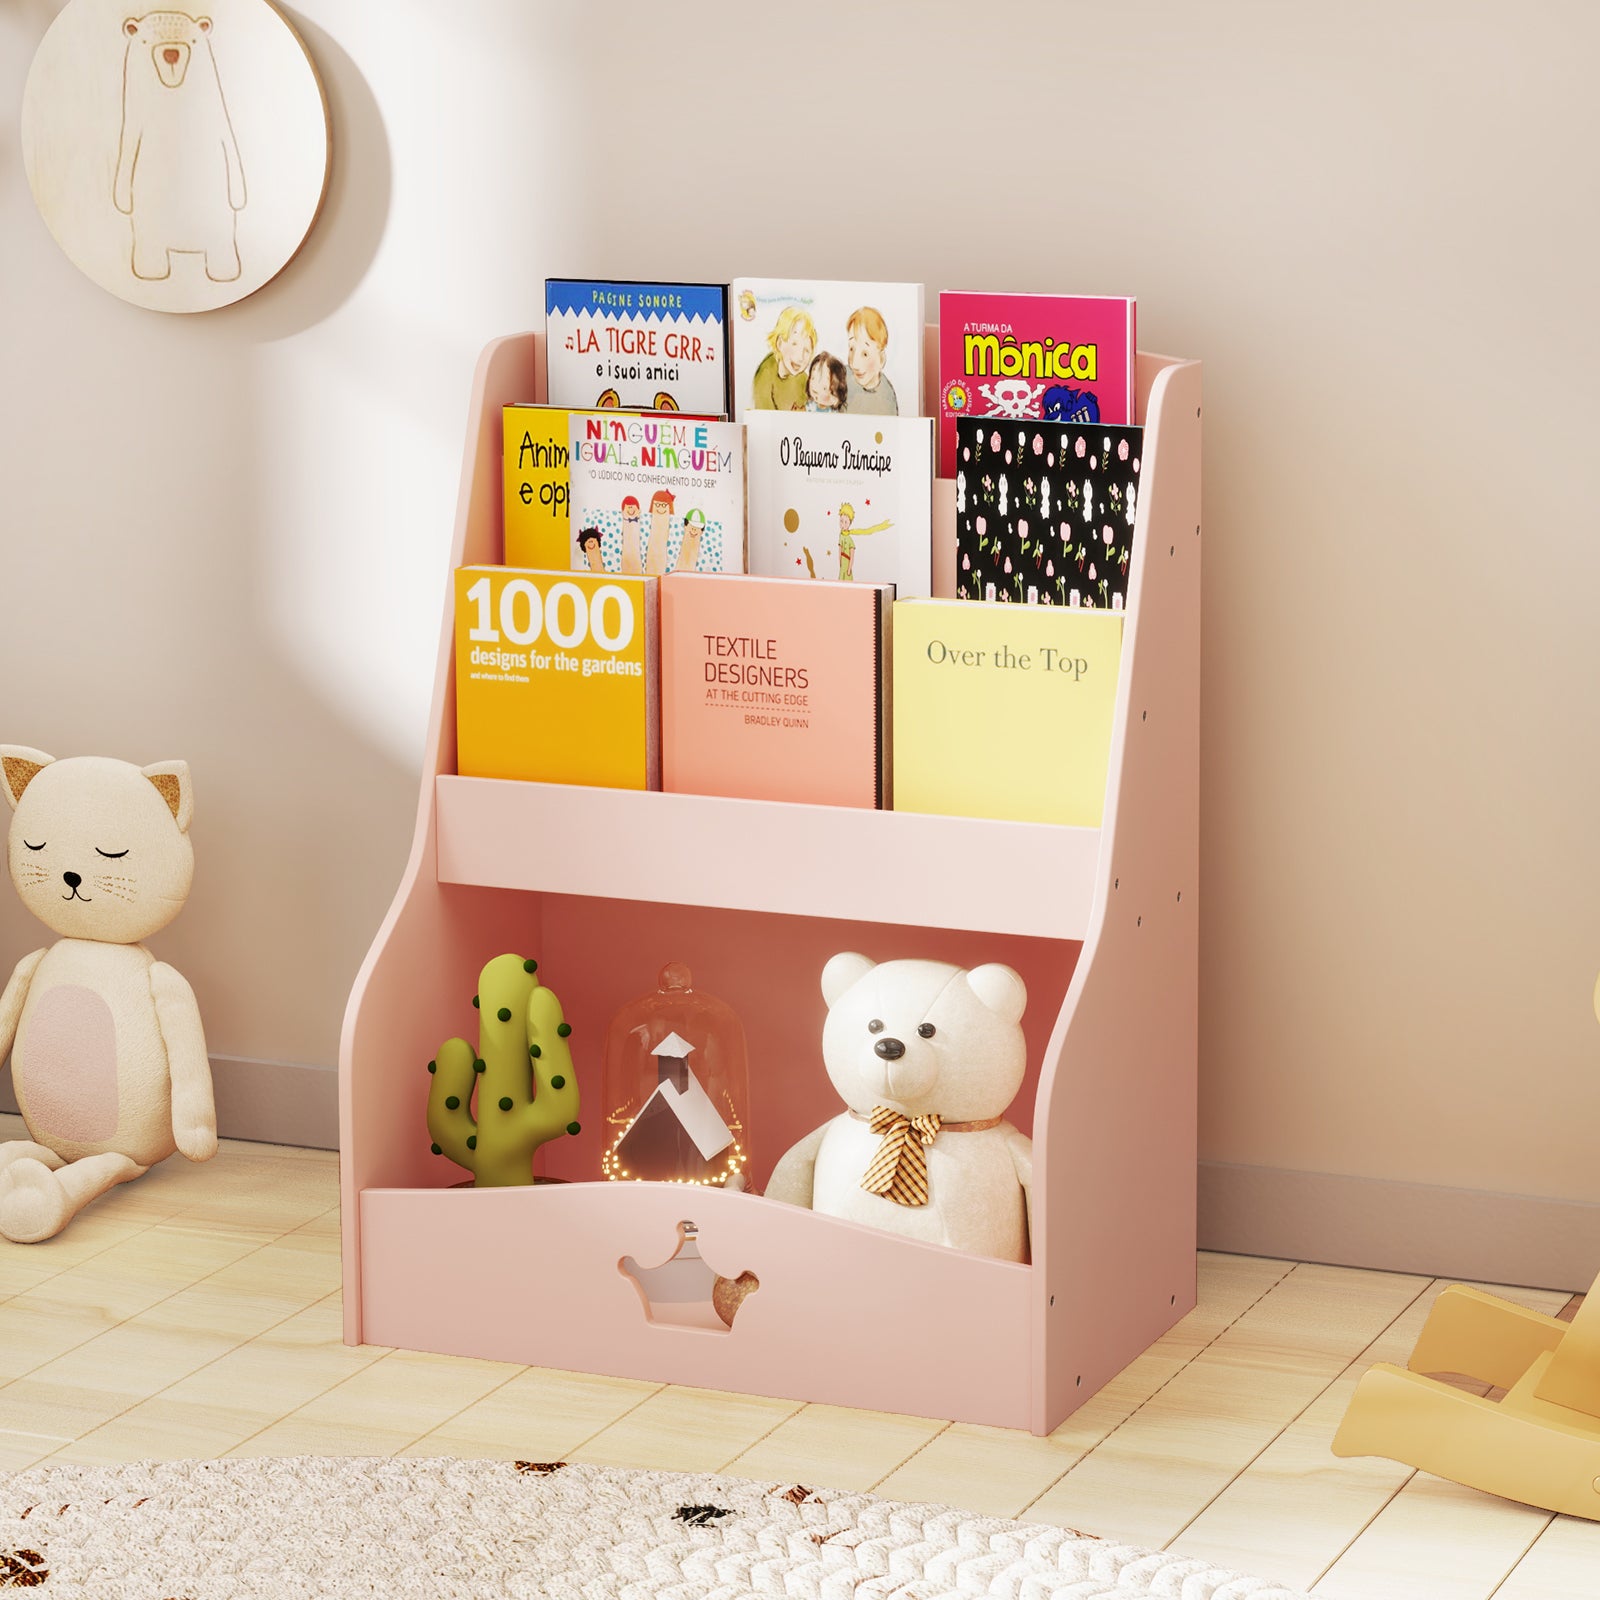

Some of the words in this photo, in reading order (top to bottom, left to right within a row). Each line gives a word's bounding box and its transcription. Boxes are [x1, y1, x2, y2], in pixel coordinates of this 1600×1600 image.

[592, 290, 632, 306] PAGINE
[638, 294, 682, 308] SONORE
[964, 323, 970, 332] A
[971, 323, 1000, 332] TURMA
[1001, 324, 1013, 333] DA
[577, 329, 600, 353] LA
[606, 327, 657, 356] TIGRE
[664, 333, 702, 363] GRR
[596, 363, 603, 376] e
[646, 364, 679, 381] amici
[694, 424, 708, 449] É
[518, 430, 570, 469] Anim
[575, 440, 629, 466] IGUAL
[631, 455, 639, 467] a
[780, 436, 790, 466] O
[793, 437, 839, 475] Pequeno
[841, 440, 892, 477] Príncipe
[598, 470, 623, 481] LÚDICO
[624, 472, 635, 482] NO
[637, 474, 690, 487] CONHECIMENTO
[691, 478, 702, 488] DO
[519, 482, 533, 504] e
[466, 577, 634, 652] 1000
[703, 635, 777, 660] TEXTILE
[470, 646, 527, 671] designs
[530, 649, 552, 670] for
[554, 652, 579, 671] the
[582, 656, 642, 677] gardens
[927, 640, 986, 667] Over
[994, 645, 1031, 670] the
[1040, 647, 1088, 682] Top
[470, 672, 481, 680] and
[481, 672, 497, 681] where
[504, 674, 515, 682] find
[515, 675, 529, 683] them
[705, 662, 809, 689] DESIGNERS
[706, 689, 718, 699] AT
[721, 690, 739, 702] THE
[741, 691, 781, 704] CUTTING
[784, 694, 809, 706] EDGE
[744, 715, 781, 726] BRADLEY
[783, 717, 809, 728] QUINN
